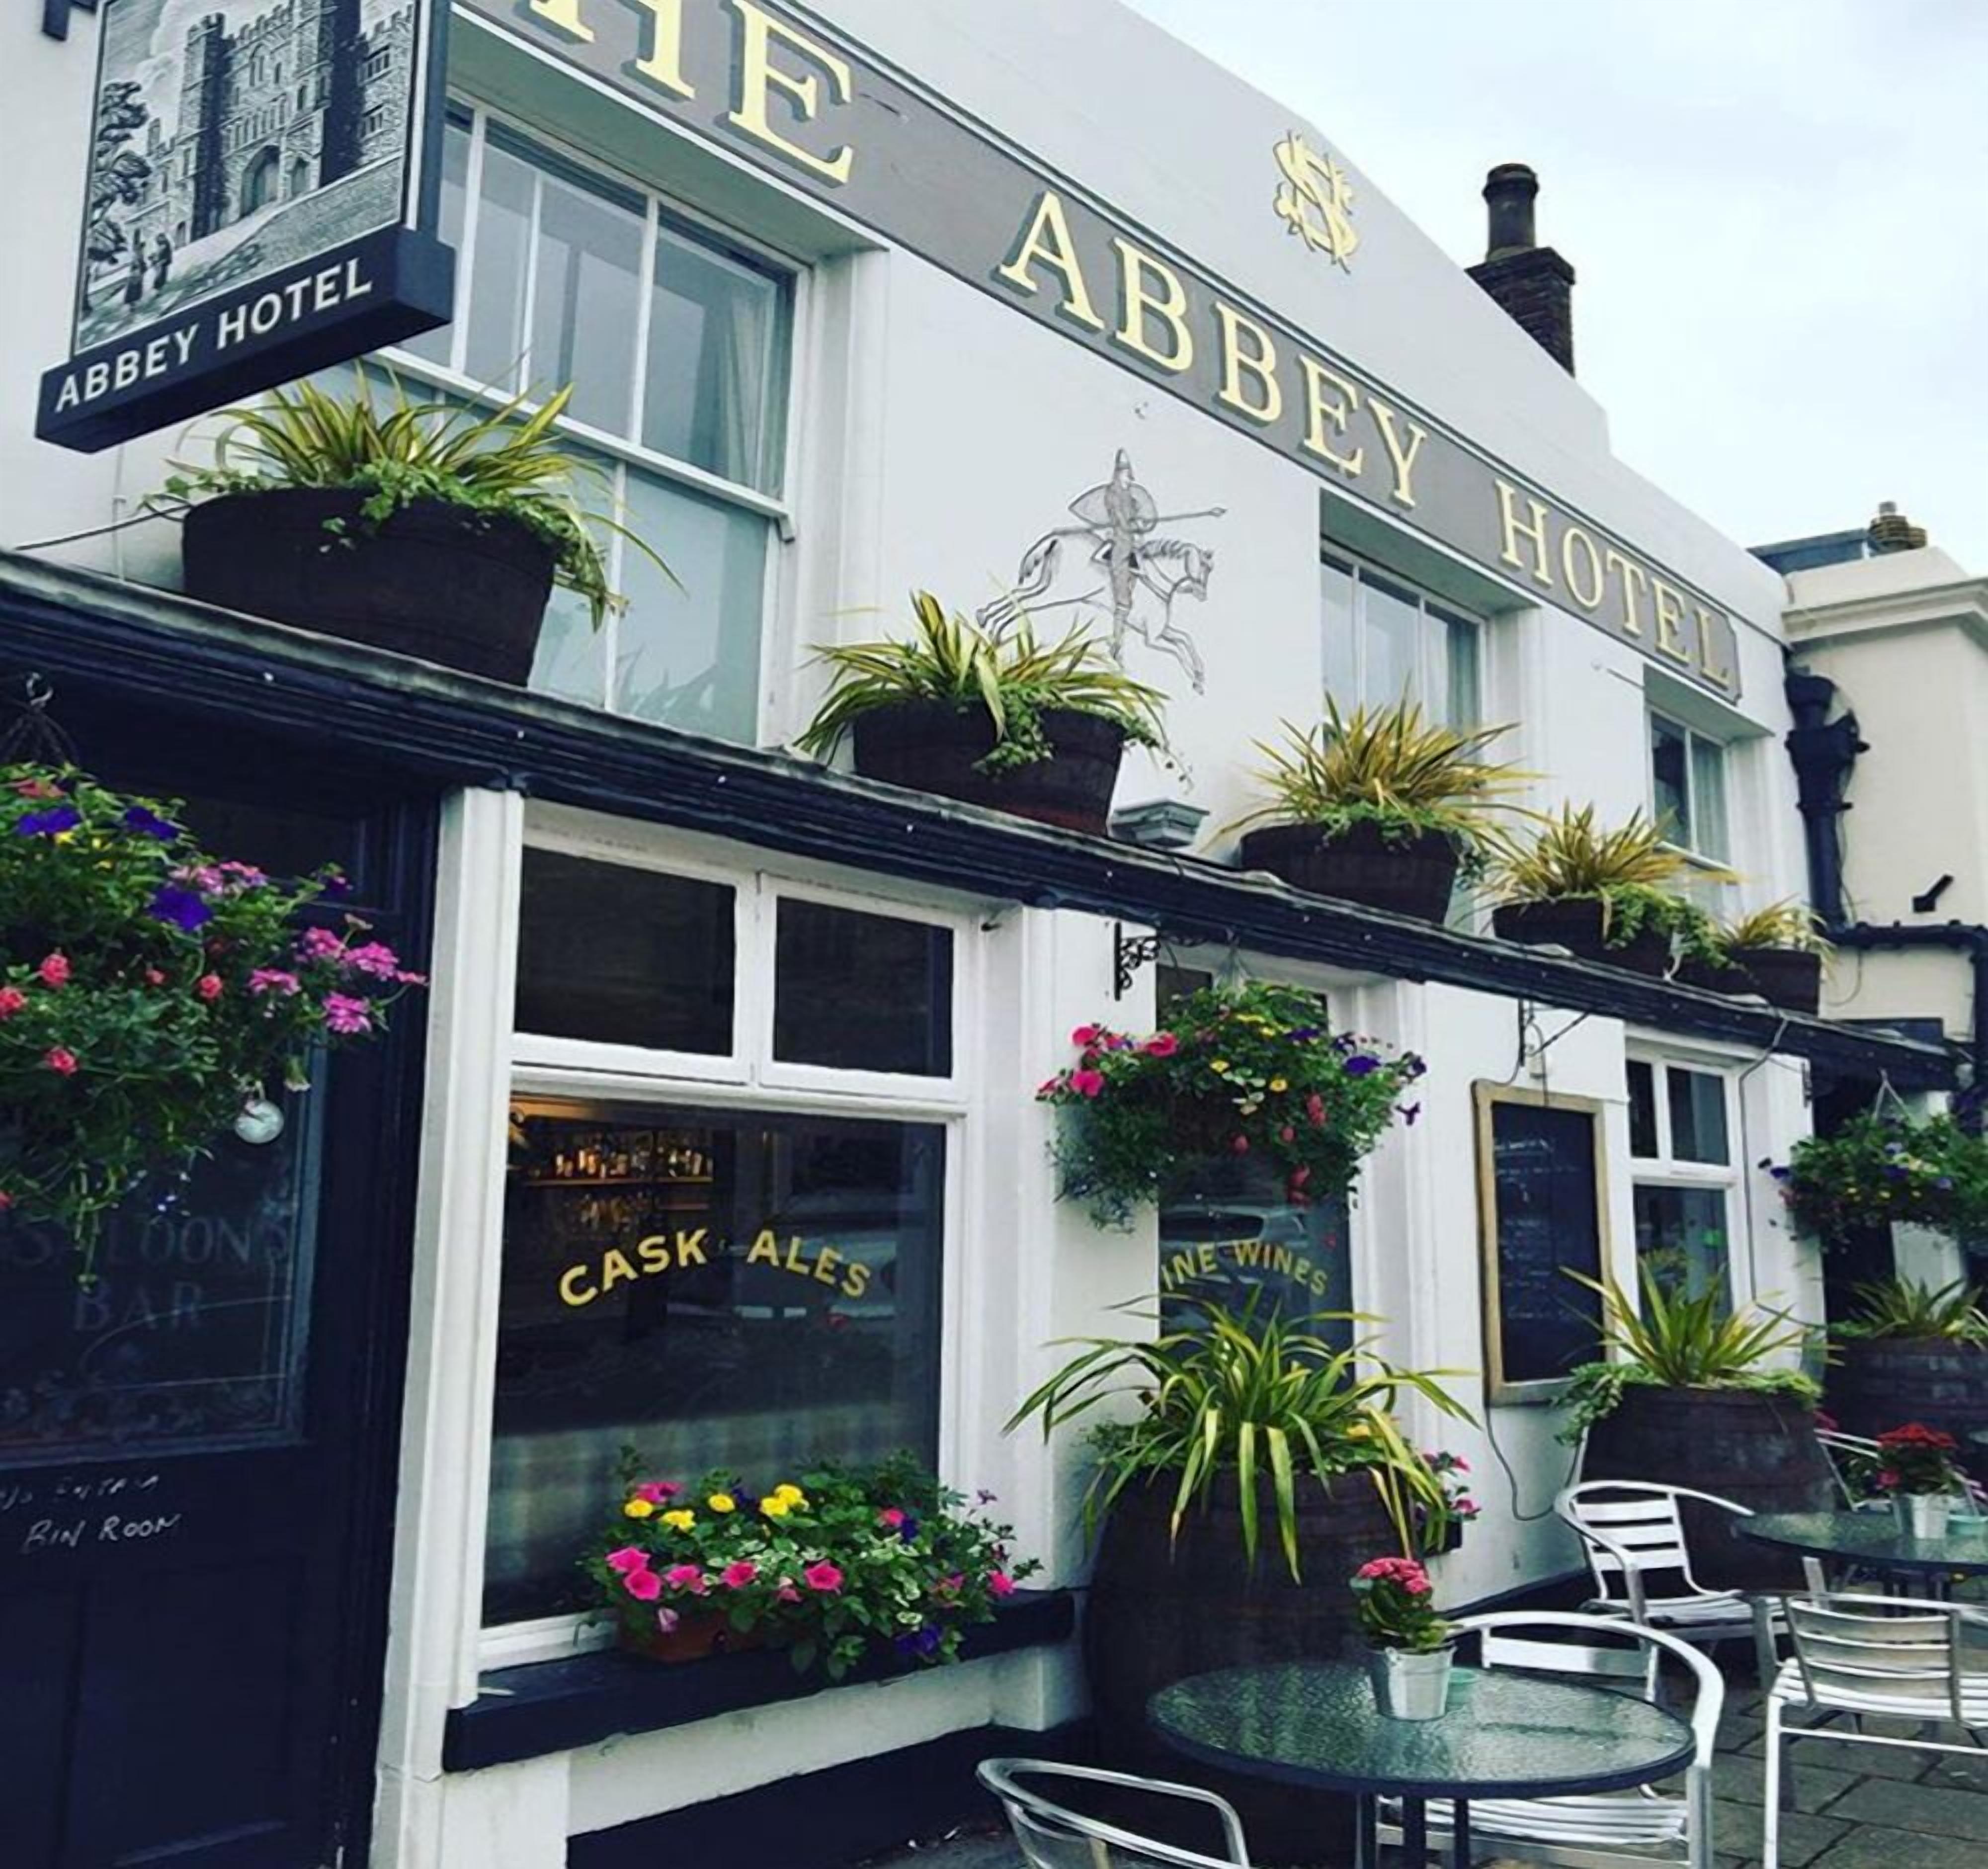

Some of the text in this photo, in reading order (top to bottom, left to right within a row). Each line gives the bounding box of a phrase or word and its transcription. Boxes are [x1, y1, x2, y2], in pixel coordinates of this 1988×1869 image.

[54, 258, 373, 413] ABBEY HOTEL
[995, 189, 1426, 507] ABBEY
[1494, 478, 1729, 691] HOTEL
[559, 1228, 872, 1306] CASK ALES
[1232, 1240, 1327, 1296] WINES
